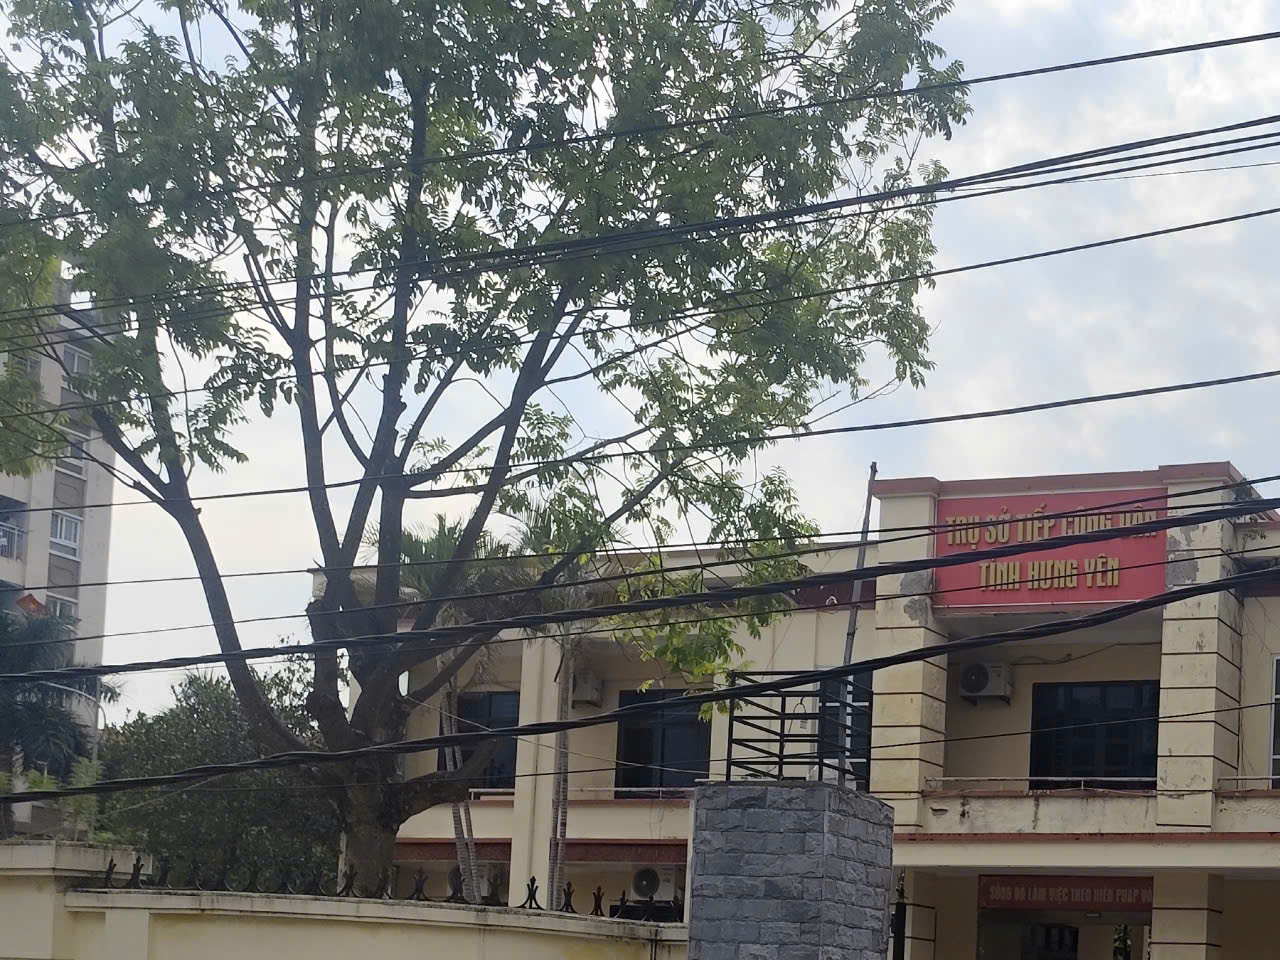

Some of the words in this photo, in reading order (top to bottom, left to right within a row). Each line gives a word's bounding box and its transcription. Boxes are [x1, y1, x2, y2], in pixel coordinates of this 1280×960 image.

[945, 514, 980, 549] TRỤ
[984, 505, 1011, 543] SỞ
[1016, 503, 1056, 543] TIẾP
[1027, 556, 1079, 590] HƯNG
[1084, 553, 1120, 588] YÊN
